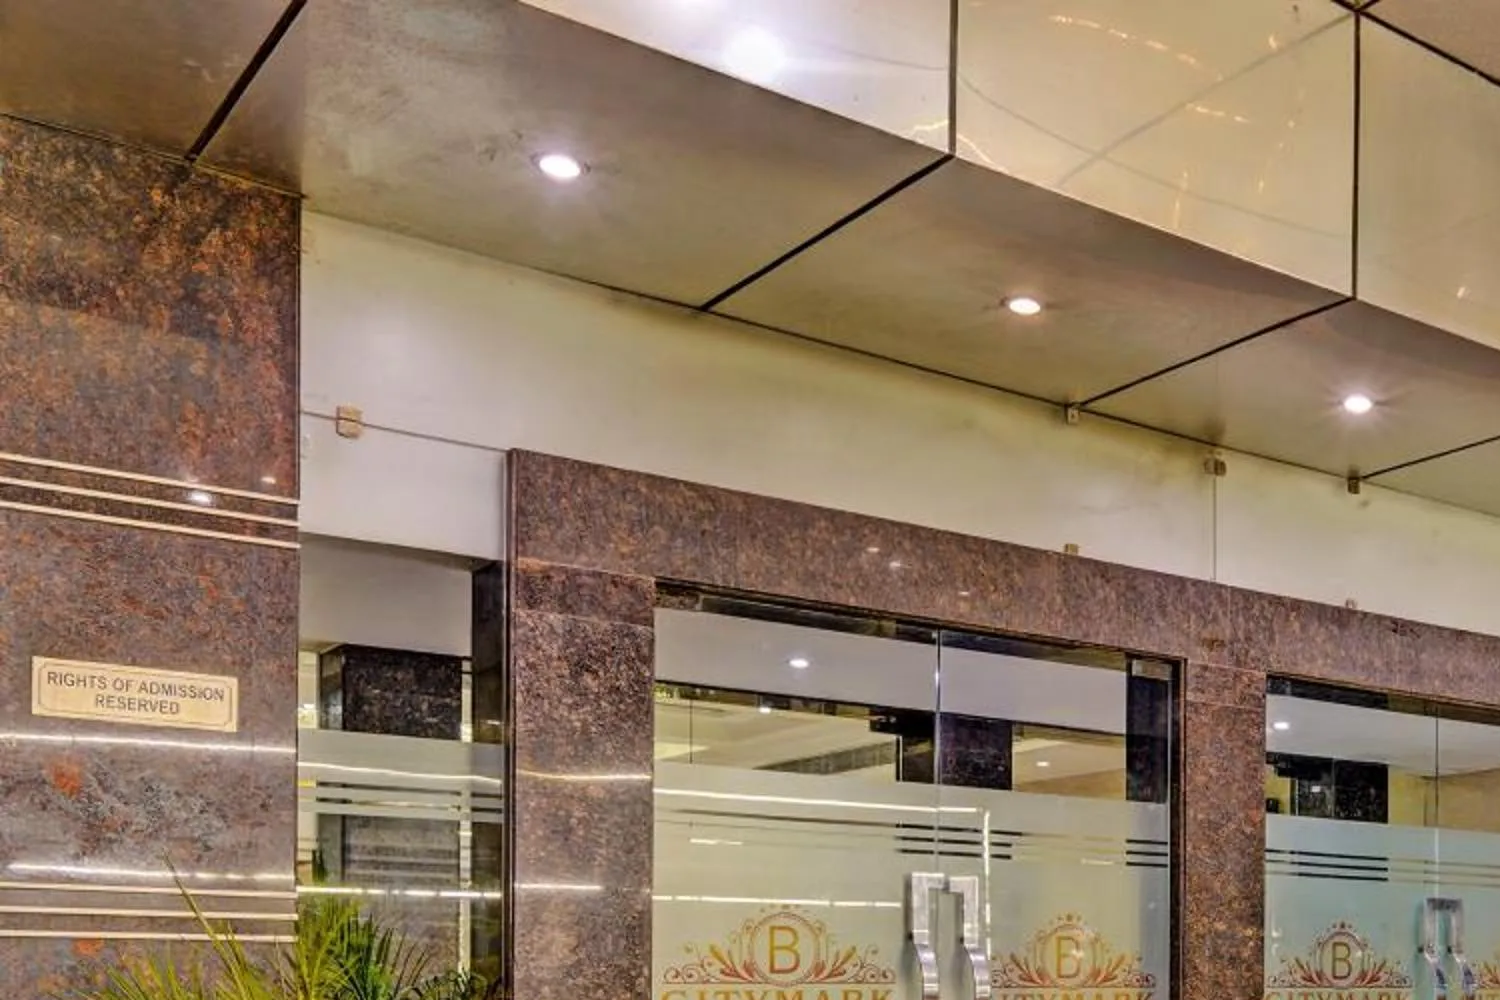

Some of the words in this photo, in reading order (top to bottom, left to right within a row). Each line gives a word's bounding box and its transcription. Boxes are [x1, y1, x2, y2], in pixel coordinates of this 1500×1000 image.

[47, 671, 108, 691] RIGHTS
[112, 679, 134, 693] OF
[137, 680, 225, 701] ADMISSION
[94, 694, 180, 715] RESERVED
[768, 925, 800, 974] B
[1331, 941, 1352, 980] B
